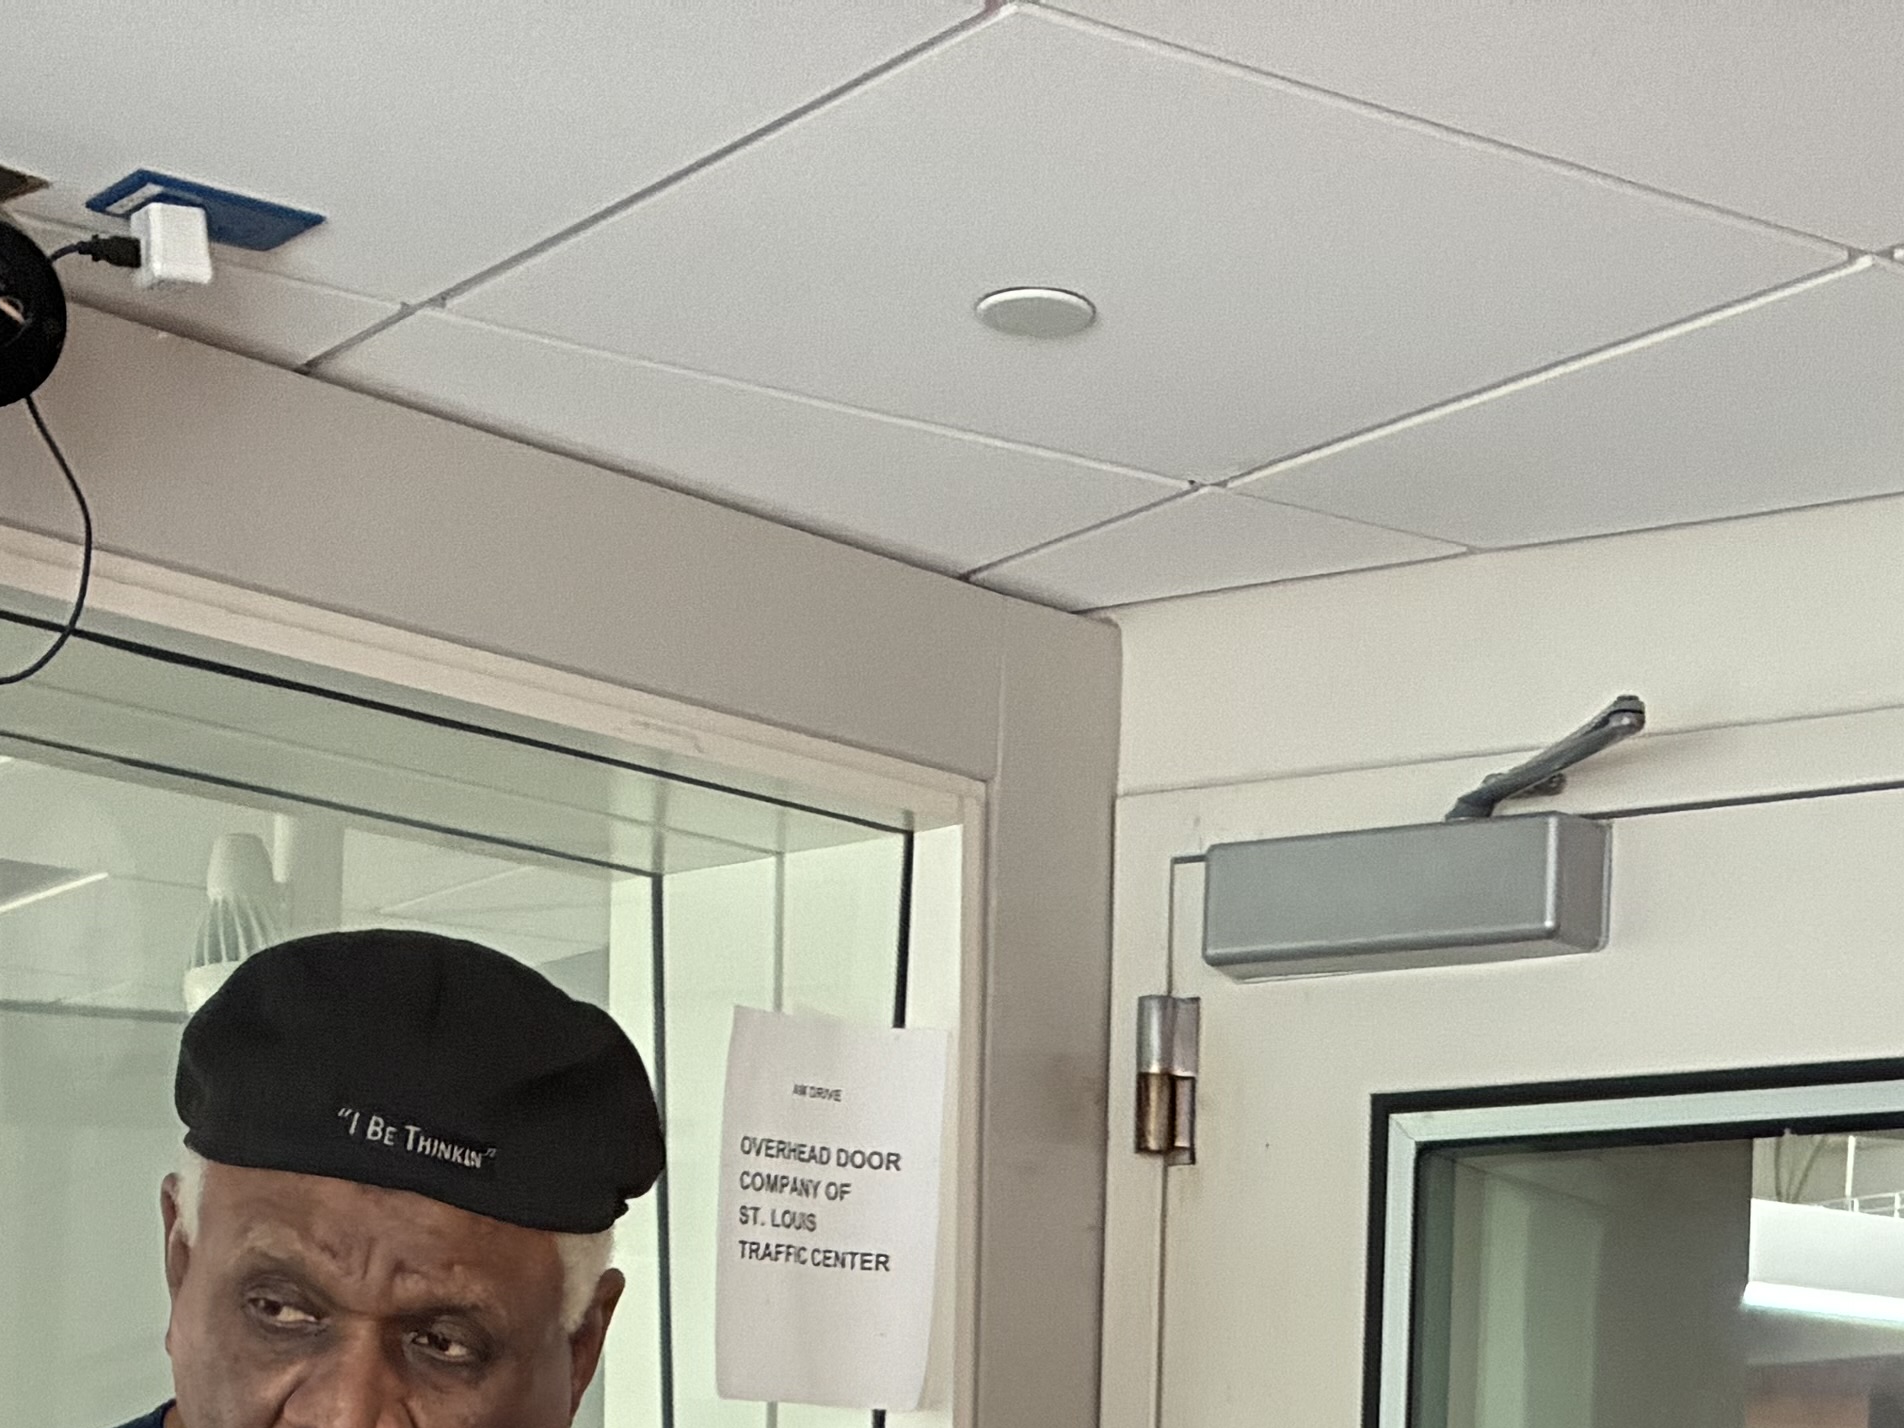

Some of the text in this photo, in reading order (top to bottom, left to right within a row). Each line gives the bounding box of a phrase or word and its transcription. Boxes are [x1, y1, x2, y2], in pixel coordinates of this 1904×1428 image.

[739, 1134, 902, 1172] OVERHEAD DOOR
[738, 1170, 853, 1202] COMPANY OF
[738, 1204, 818, 1233] ST. LOUIS
[738, 1239, 892, 1273] TRAFFIC CENTER
